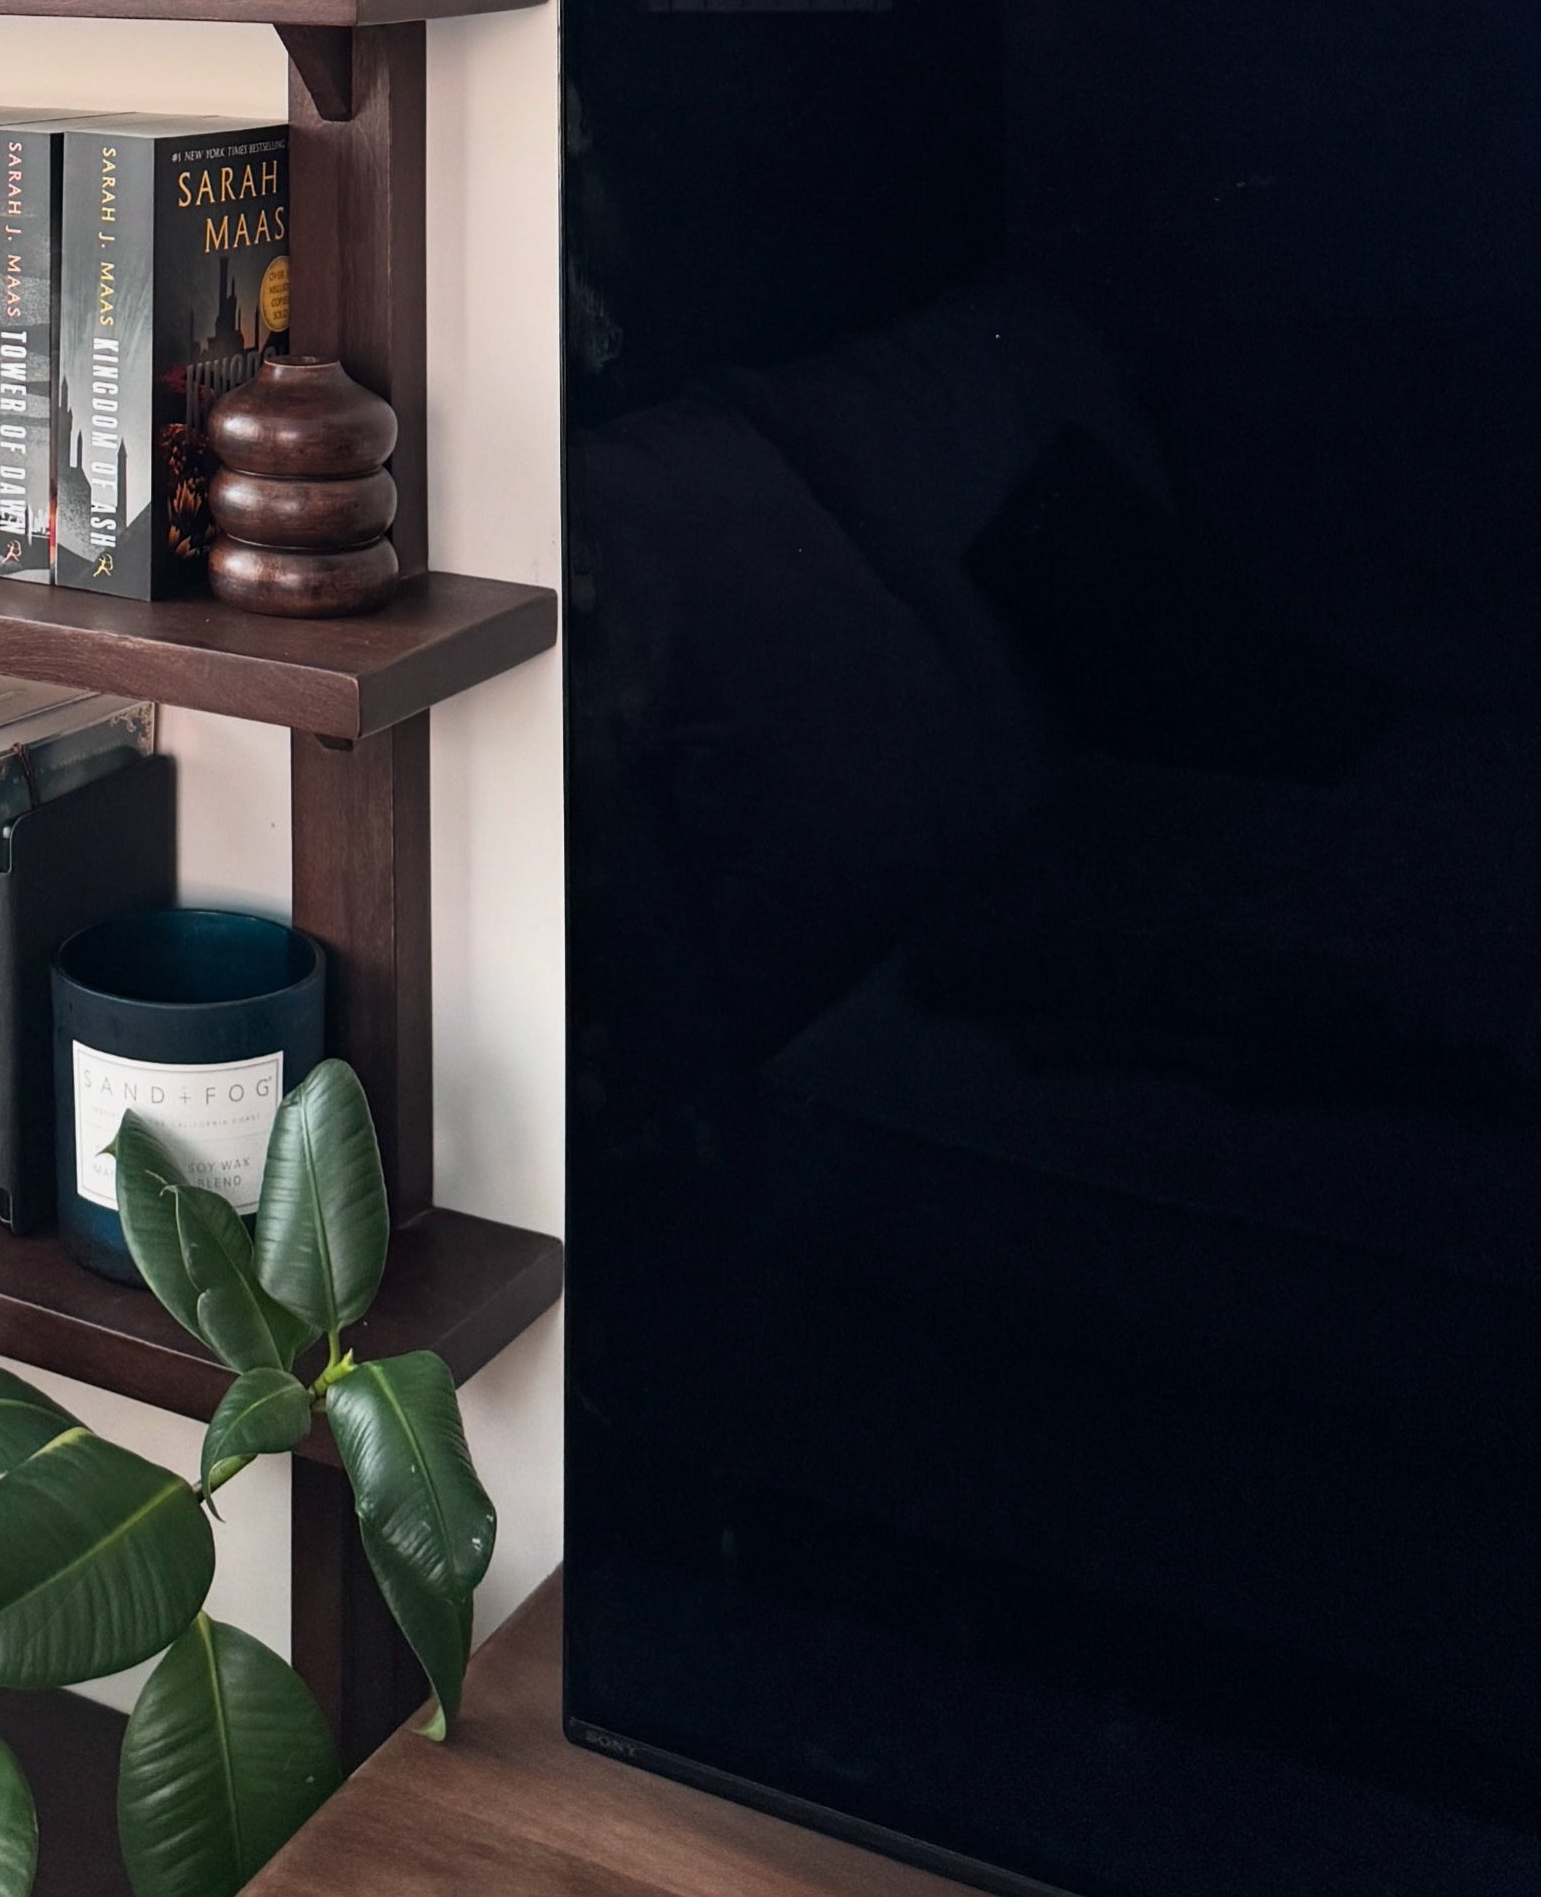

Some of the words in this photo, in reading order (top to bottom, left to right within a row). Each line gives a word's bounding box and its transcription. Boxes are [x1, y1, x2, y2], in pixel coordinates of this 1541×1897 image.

[184, 149, 204, 162] NEW
[205, 146, 226, 160] YORK
[227, 143, 248, 157] TIMES
[7, 141, 23, 216] SARAH
[101, 146, 116, 223] SARAH
[178, 160, 278, 208] SARAH
[205, 206, 285, 254] MAAS
[7, 254, 22, 319] MAAS
[99, 261, 115, 327] MAAS
[0, 331, 28, 413] TOWER
[92, 337, 119, 449] KINGDOM
[0, 423, 27, 455] OF
[0, 465, 26, 535] DAWN
[90, 461, 118, 493] OF
[89, 502, 117, 548] ASH
[83, 1068, 166, 1105] SAND
[187, 1161, 215, 1175] SOY
[221, 1156, 251, 1172] WAX
[197, 1175, 242, 1189] BLEND
